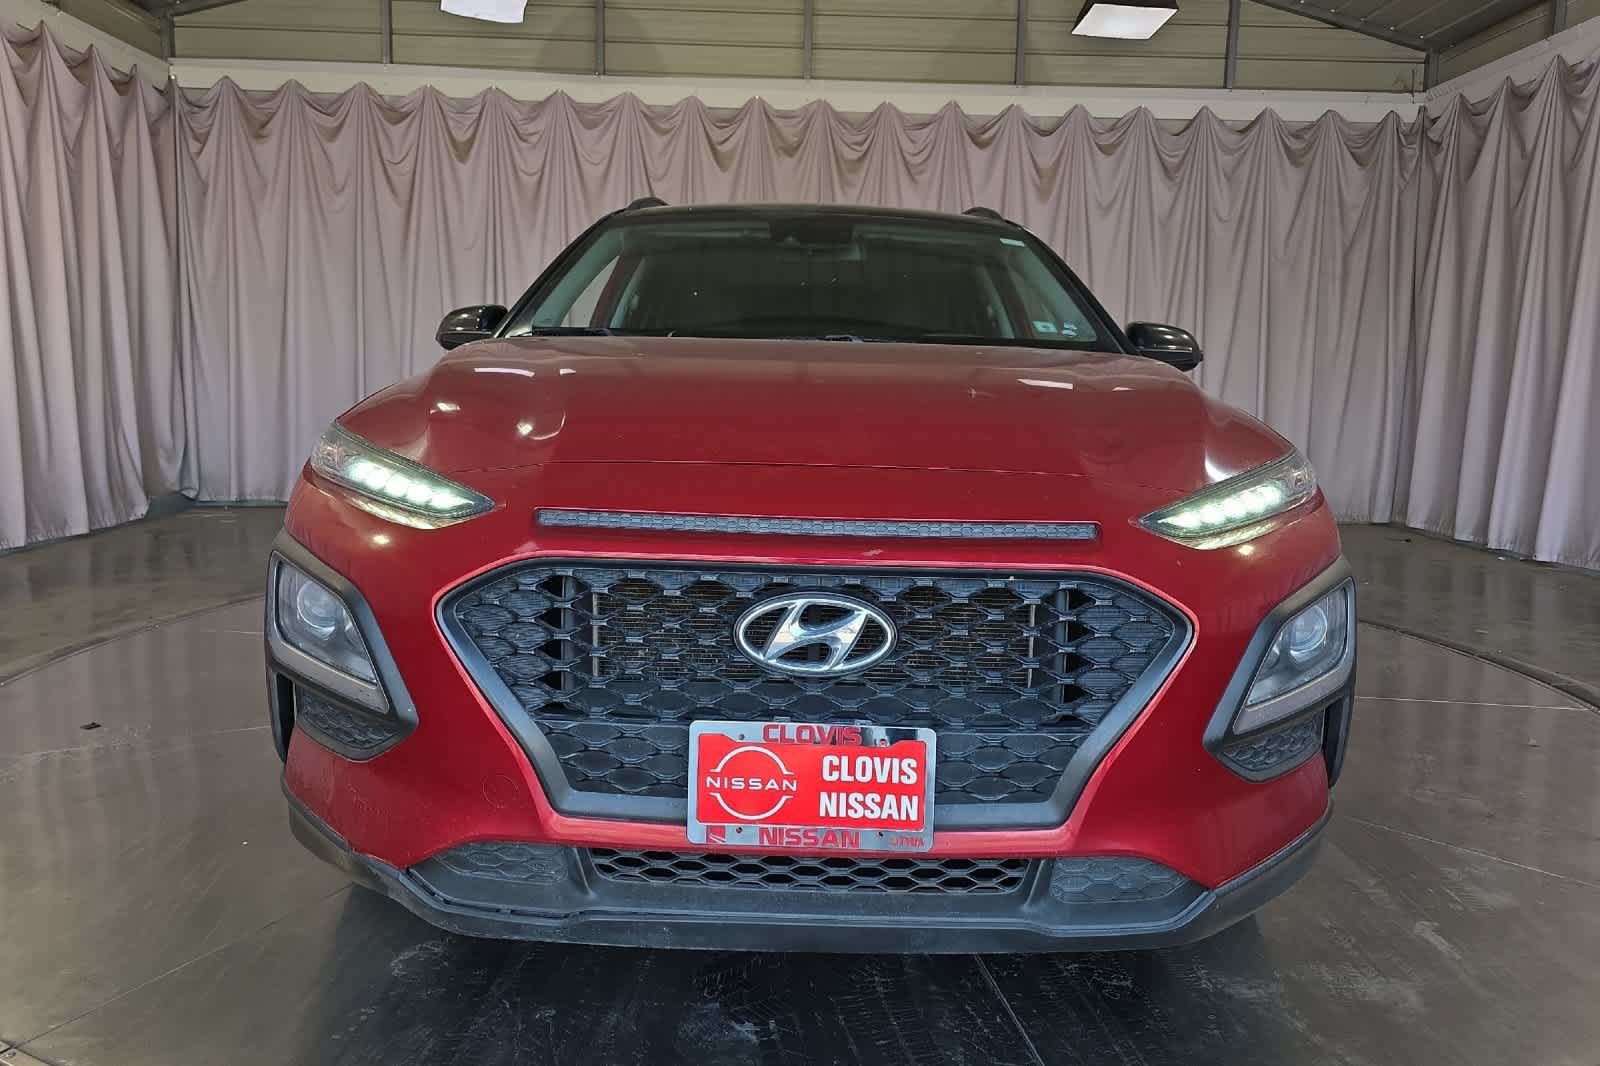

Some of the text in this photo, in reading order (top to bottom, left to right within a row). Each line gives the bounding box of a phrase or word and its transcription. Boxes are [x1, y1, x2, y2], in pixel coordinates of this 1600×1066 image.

[763, 724, 863, 745] CLOVIS
[822, 755, 918, 785] CLOVIS
[705, 776, 798, 792] NISSAN
[819, 791, 918, 821] NISSAN
[758, 826, 860, 849] NISSAN
